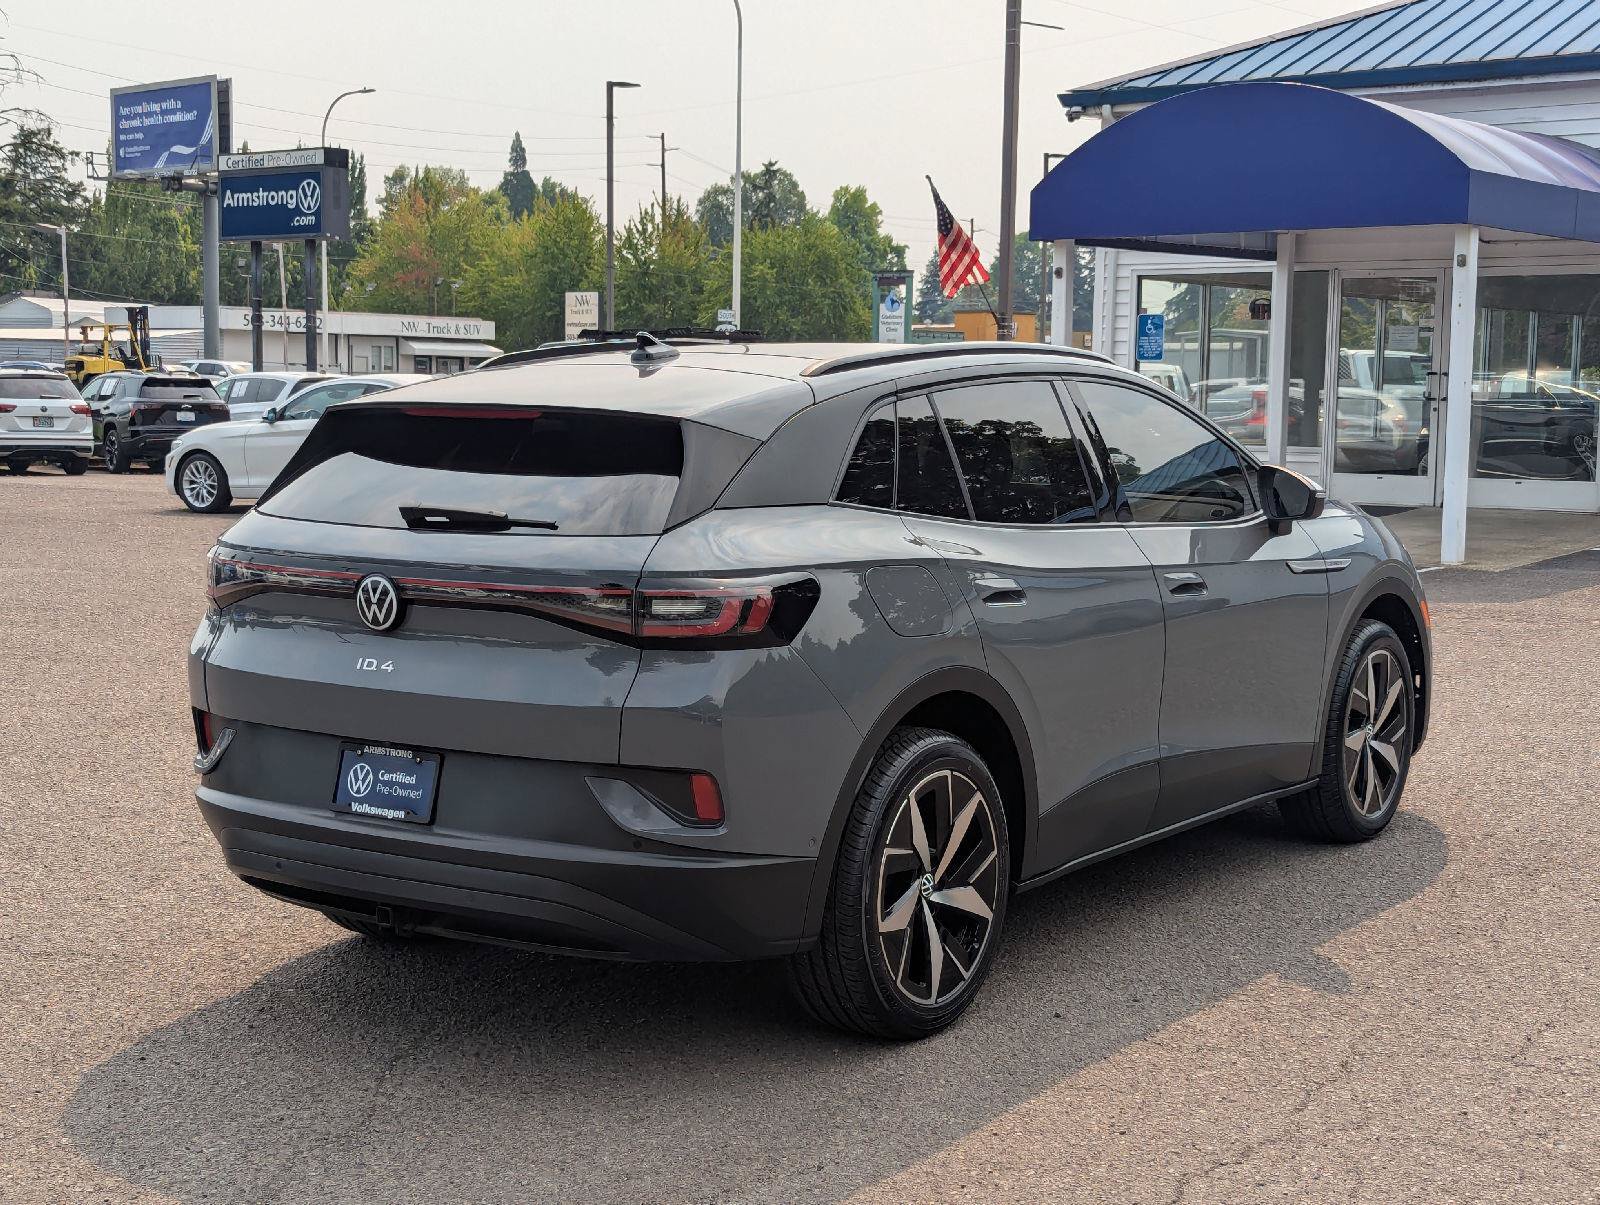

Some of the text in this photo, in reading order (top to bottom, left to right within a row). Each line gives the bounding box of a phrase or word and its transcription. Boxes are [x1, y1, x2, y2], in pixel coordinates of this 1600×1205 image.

[120, 105, 130, 116] Are
[130, 105, 142, 117] you
[142, 101, 160, 114] living
[161, 99, 177, 110] with
[119, 117, 142, 129] chronic
[163, 110, 197, 123] condition?
[226, 152, 317, 169] Certified Pre-Owned
[223, 187, 297, 209] Armstrong
[291, 215, 316, 226] .com
[400, 320, 481, 336] NW Truck & SUV
[363, 745, 413, 759] ARMSTRONG
[378, 770, 417, 784] Certified
[376, 783, 423, 799] Pre-Owned
[351, 801, 405, 819] Volkswagen
